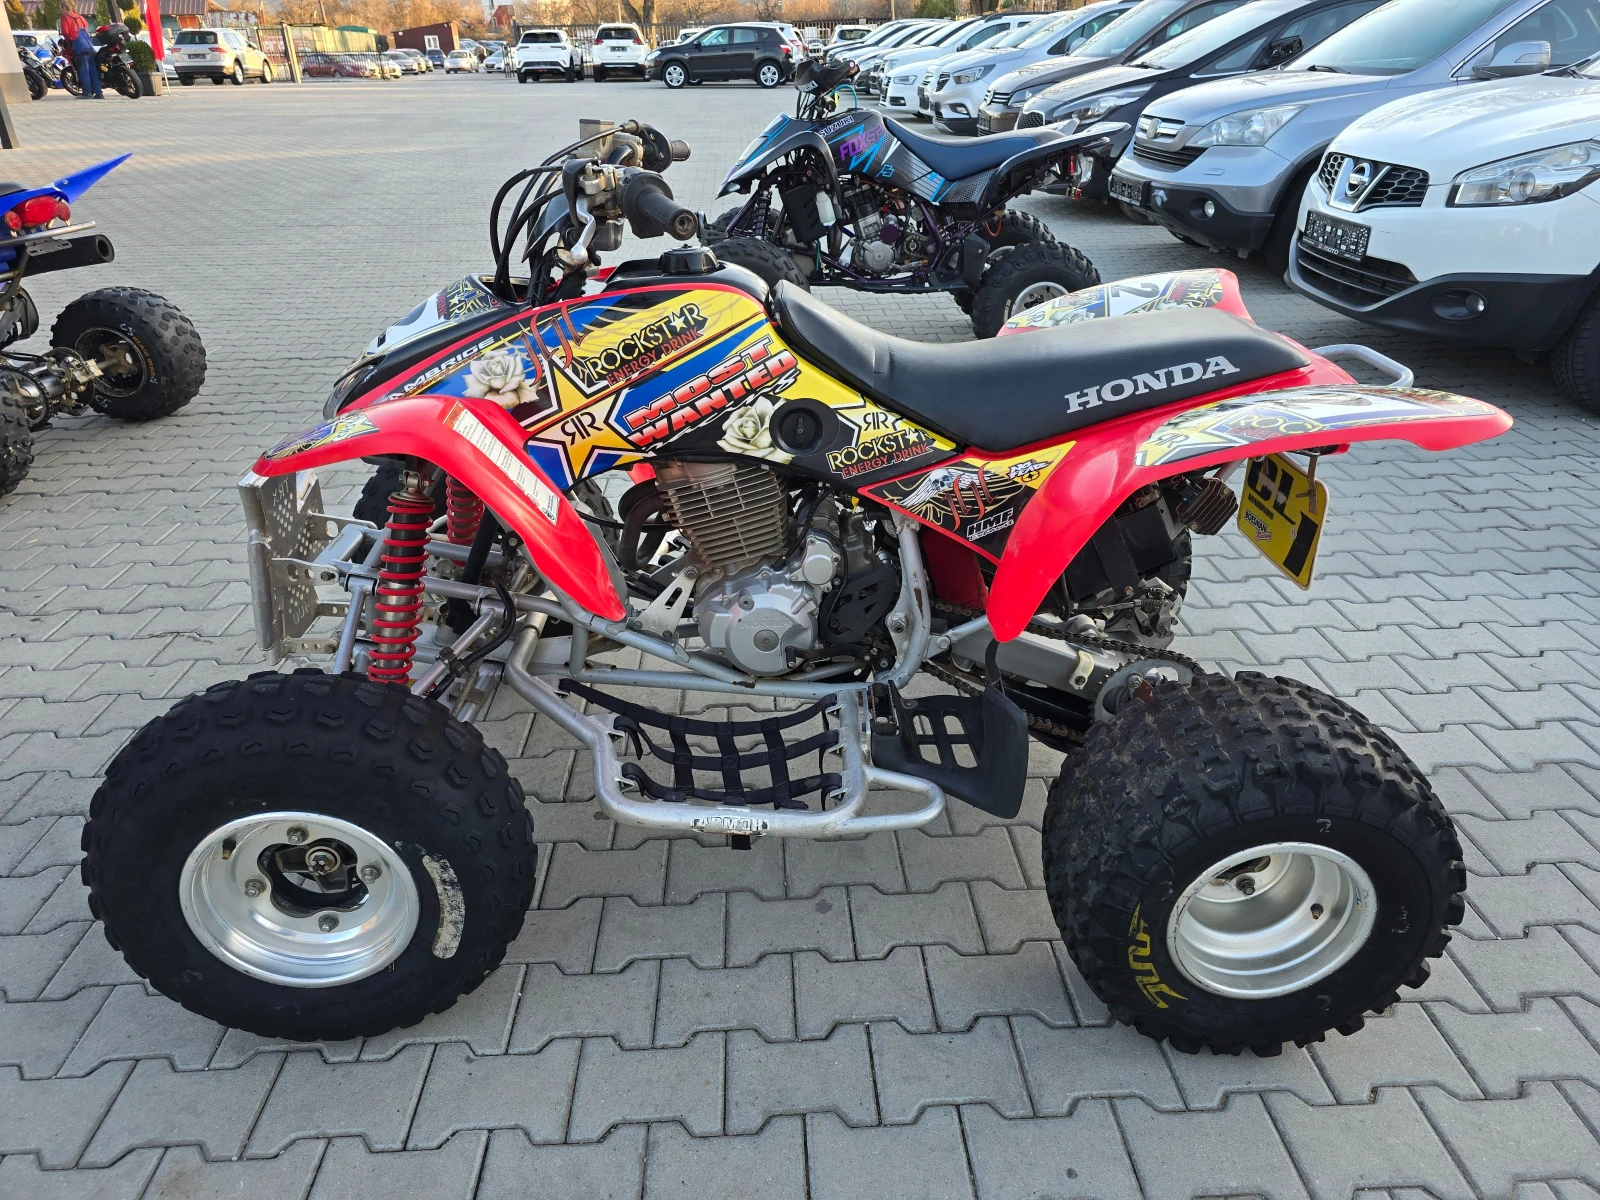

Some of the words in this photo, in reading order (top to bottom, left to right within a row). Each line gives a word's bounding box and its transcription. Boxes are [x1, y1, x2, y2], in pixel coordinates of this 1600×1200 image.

[819, 115, 855, 137] SUZUKI
[839, 131, 868, 161] FOX
[606, 350, 657, 386] ENERGY
[661, 327, 701, 356] DRINK
[624, 335, 773, 430] MOST
[626, 349, 798, 447] WANTED
[1064, 355, 1240, 414] HONDA
[842, 454, 888, 477] ENERGY
[893, 442, 930, 462] DRINK
[966, 508, 1014, 537] HMF
